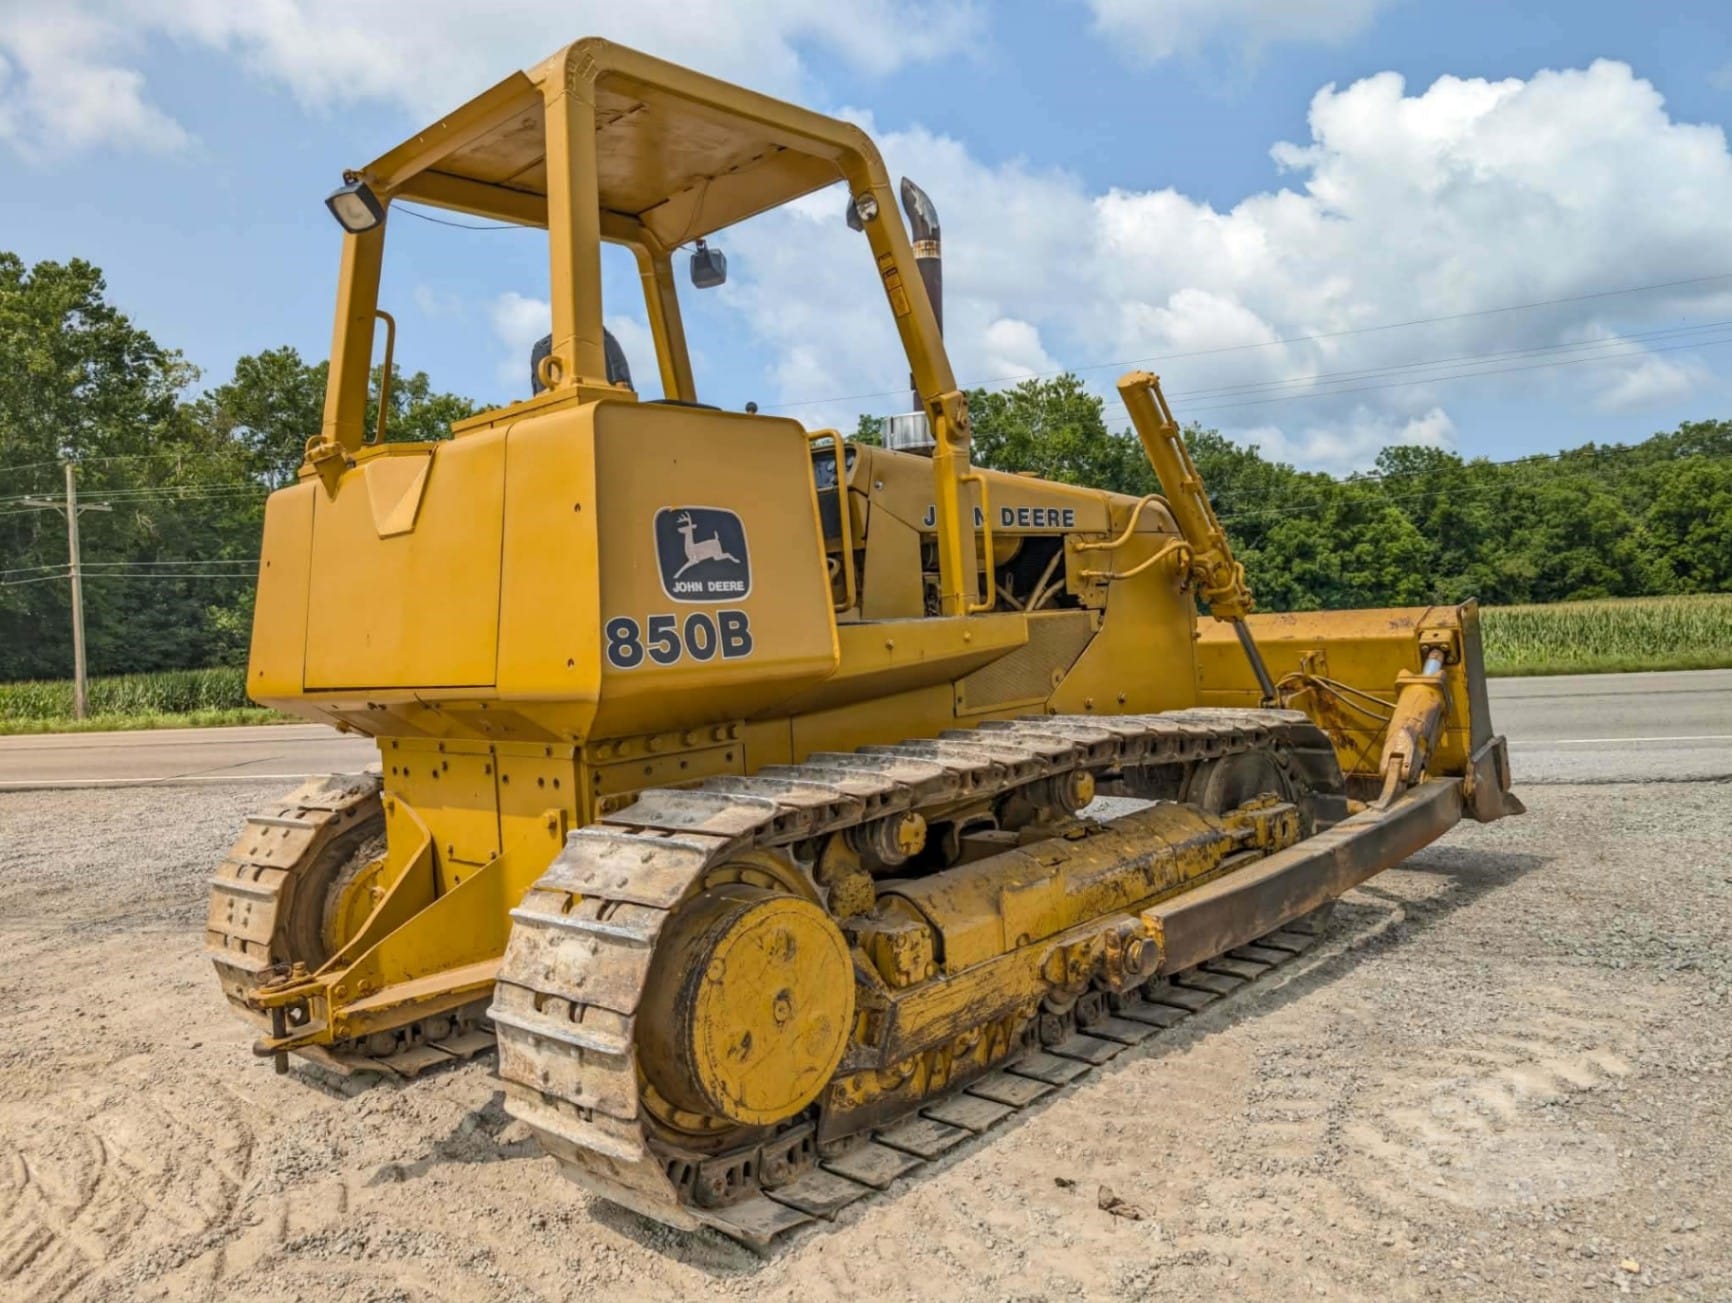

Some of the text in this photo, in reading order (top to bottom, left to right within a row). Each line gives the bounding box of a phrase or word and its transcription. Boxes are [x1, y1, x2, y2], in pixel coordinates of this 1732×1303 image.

[923, 505, 1075, 528] JN DEERE
[672, 581, 745, 592] JOHN DEERE
[605, 609, 753, 669] 850B
